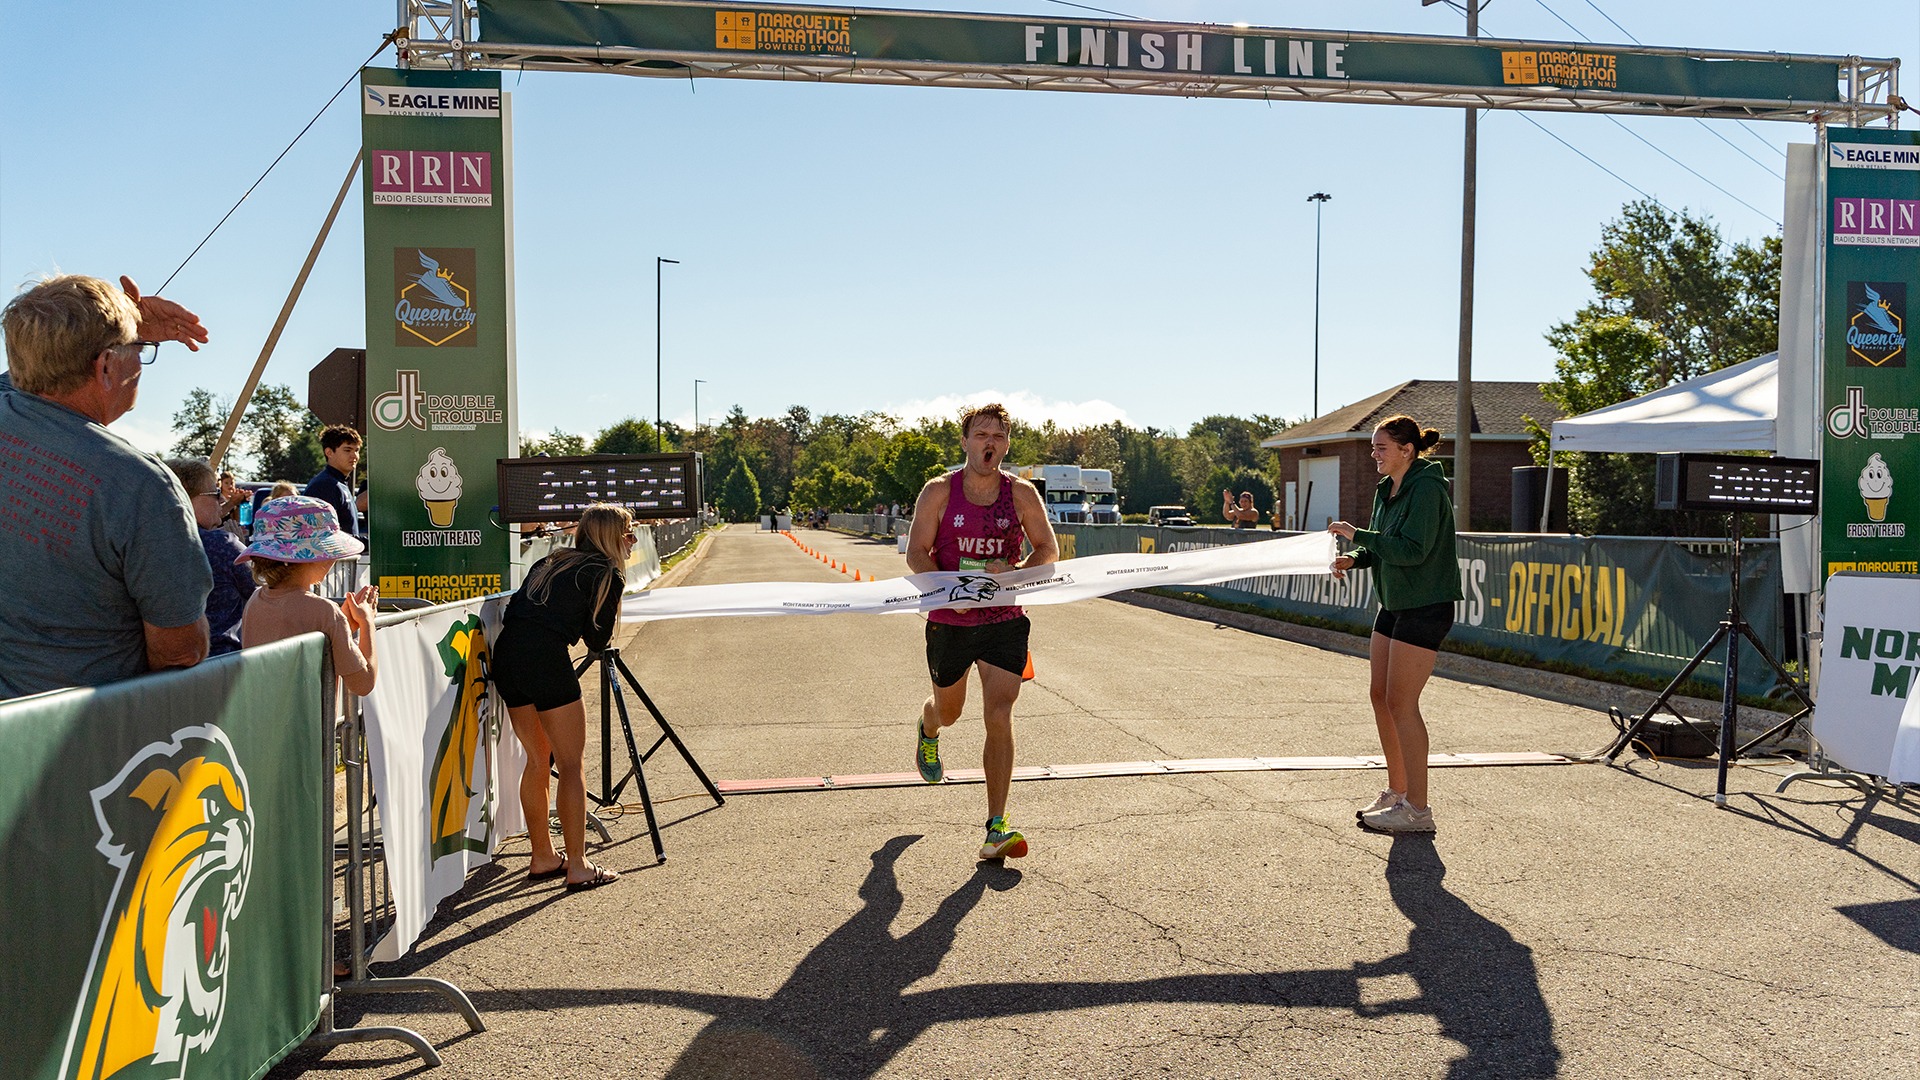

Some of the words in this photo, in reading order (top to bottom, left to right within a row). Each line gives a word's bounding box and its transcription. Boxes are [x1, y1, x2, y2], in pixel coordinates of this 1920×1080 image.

[758, 13, 850, 30] MARQUETTE
[758, 28, 850, 45] MARATHON
[758, 43, 806, 52] POWERED
[811, 44, 822, 52] BY
[827, 45, 850, 53] NMU
[1025, 25, 1202, 71] FINISH
[1233, 37, 1345, 78] LINE
[1539, 51, 1616, 68] MARQUETTE
[1540, 64, 1617, 81] MARATHON
[1541, 77, 1579, 86] POWERED
[1583, 79, 1593, 87] BY
[1597, 80, 1617, 88] NMU
[388, 93, 449, 109] EAGLE
[453, 96, 499, 110] MINE
[1847, 149, 1891, 163] EAGLE
[375, 195, 402, 203] RADIO
[405, 195, 443, 203] RESULTS
[446, 196, 490, 204] NETWORK
[1835, 235, 1855, 243] RADIO
[1857, 236, 1885, 244] RESULTS
[1887, 236, 1919, 245] NETWORK
[395, 299, 452, 325] Queen
[452, 307, 476, 325] City
[1847, 325, 1889, 348] Queen
[1888, 333, 1906, 348] City
[428, 395, 495, 409] DOUBLE
[429, 410, 502, 424] TROUBLE
[1869, 408, 1918, 421] DOUBLE
[402, 530, 442, 546] FROSTY
[443, 530, 481, 546] TREATS
[1847, 524, 1877, 537] FROSTY
[1877, 524, 1905, 537] TREATS
[957, 537, 1005, 555] WEST
[1858, 561, 1918, 572] MARQUETTE
[417, 574, 501, 587] MARQUETTE
[919, 586, 946, 599] MARATHON
[1505, 561, 1626, 647] OFFICIAL
[1871, 662, 1920, 699] M
